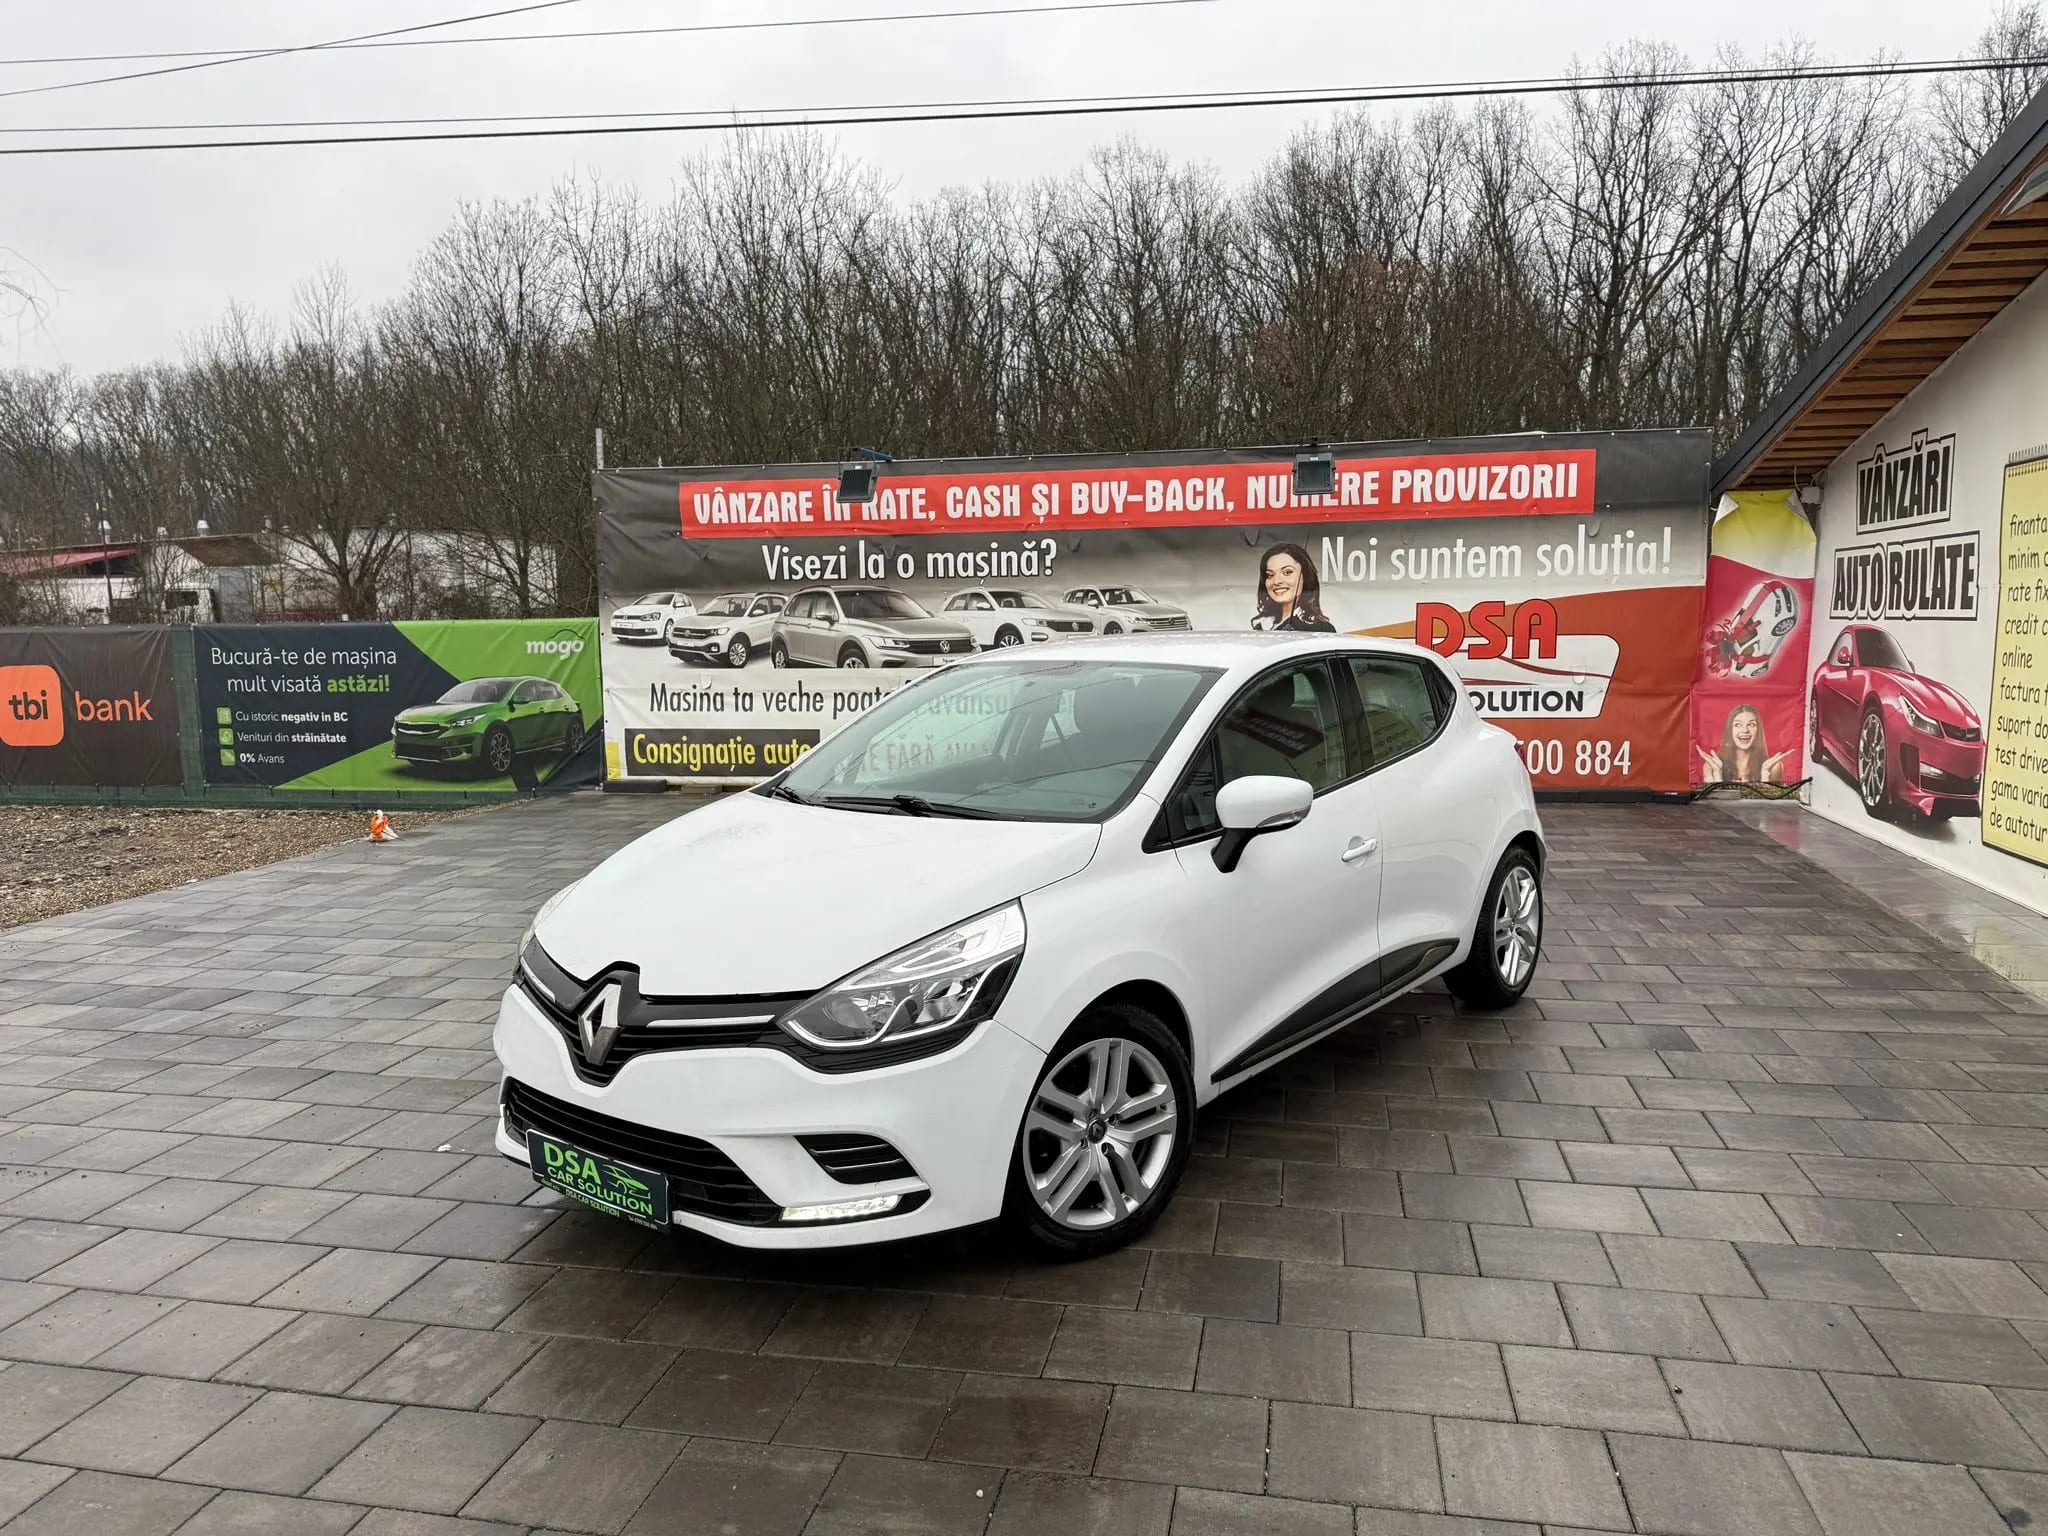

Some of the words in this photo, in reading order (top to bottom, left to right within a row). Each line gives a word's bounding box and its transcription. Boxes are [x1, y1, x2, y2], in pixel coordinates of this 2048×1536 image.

[693, 486, 814, 525] VÂNZARE
[946, 484, 1021, 519] CASH
[1031, 482, 1060, 524] ȘI
[1071, 477, 1235, 516] BUY-BACK,
[1391, 463, 1578, 505] PROVIZORII
[1859, 440, 1951, 526] VÂNZĂRI
[2009, 513, 2048, 540] finanta
[762, 544, 847, 581] Visezi
[858, 539, 885, 580] la
[896, 552, 915, 580] o
[927, 537, 1057, 585] mașină?
[1321, 536, 1378, 584] Noi
[1390, 538, 1522, 580] suntem
[1536, 523, 1672, 584] soluția!
[2008, 546, 2040, 571] minim
[1888, 542, 1976, 611] RULATE
[2007, 582, 2031, 602] rate
[1415, 598, 1558, 660] DSA
[2005, 612, 2039, 636] credit
[211, 647, 299, 666] Bucură-te
[303, 647, 327, 665] de
[332, 647, 397, 669] mașina
[526, 640, 584, 660] mogo
[2002, 645, 2033, 669] online
[227, 676, 267, 692] mult
[271, 674, 322, 693] visată
[327, 674, 391, 693] astăzi!
[2000, 677, 2041, 704] factura
[9, 690, 48, 721] tbi
[74, 690, 153, 722] bank
[650, 683, 725, 713] Masina
[733, 686, 754, 713] ta
[763, 680, 824, 713] veche
[832, 687, 891, 720] poat
[235, 711, 249, 722] Cu
[251, 710, 279, 722] istoric
[281, 711, 319, 724] negativ
[333, 711, 349, 722] BC
[1996, 714, 2031, 739] suport
[237, 731, 273, 743] Venituri
[274, 732, 290, 743] din
[291, 733, 347, 743] străinătate
[239, 753, 256, 764] 0%
[257, 754, 285, 765] Avans
[633, 733, 756, 773] Consignație
[1516, 739, 1564, 775] 00
[1574, 740, 1632, 776] 884
[1995, 743, 2017, 766] test
[2019, 746, 2048, 775] drive
[1991, 778, 2019, 801] gama
[1989, 805, 2003, 829] de
[2005, 814, 2048, 843] autotur
[543, 1141, 602, 1185] DSA
[547, 1166, 575, 1185] CAR
[577, 1178, 653, 1216] SOLUTION
[590, 1201, 621, 1218] SOLUTION
